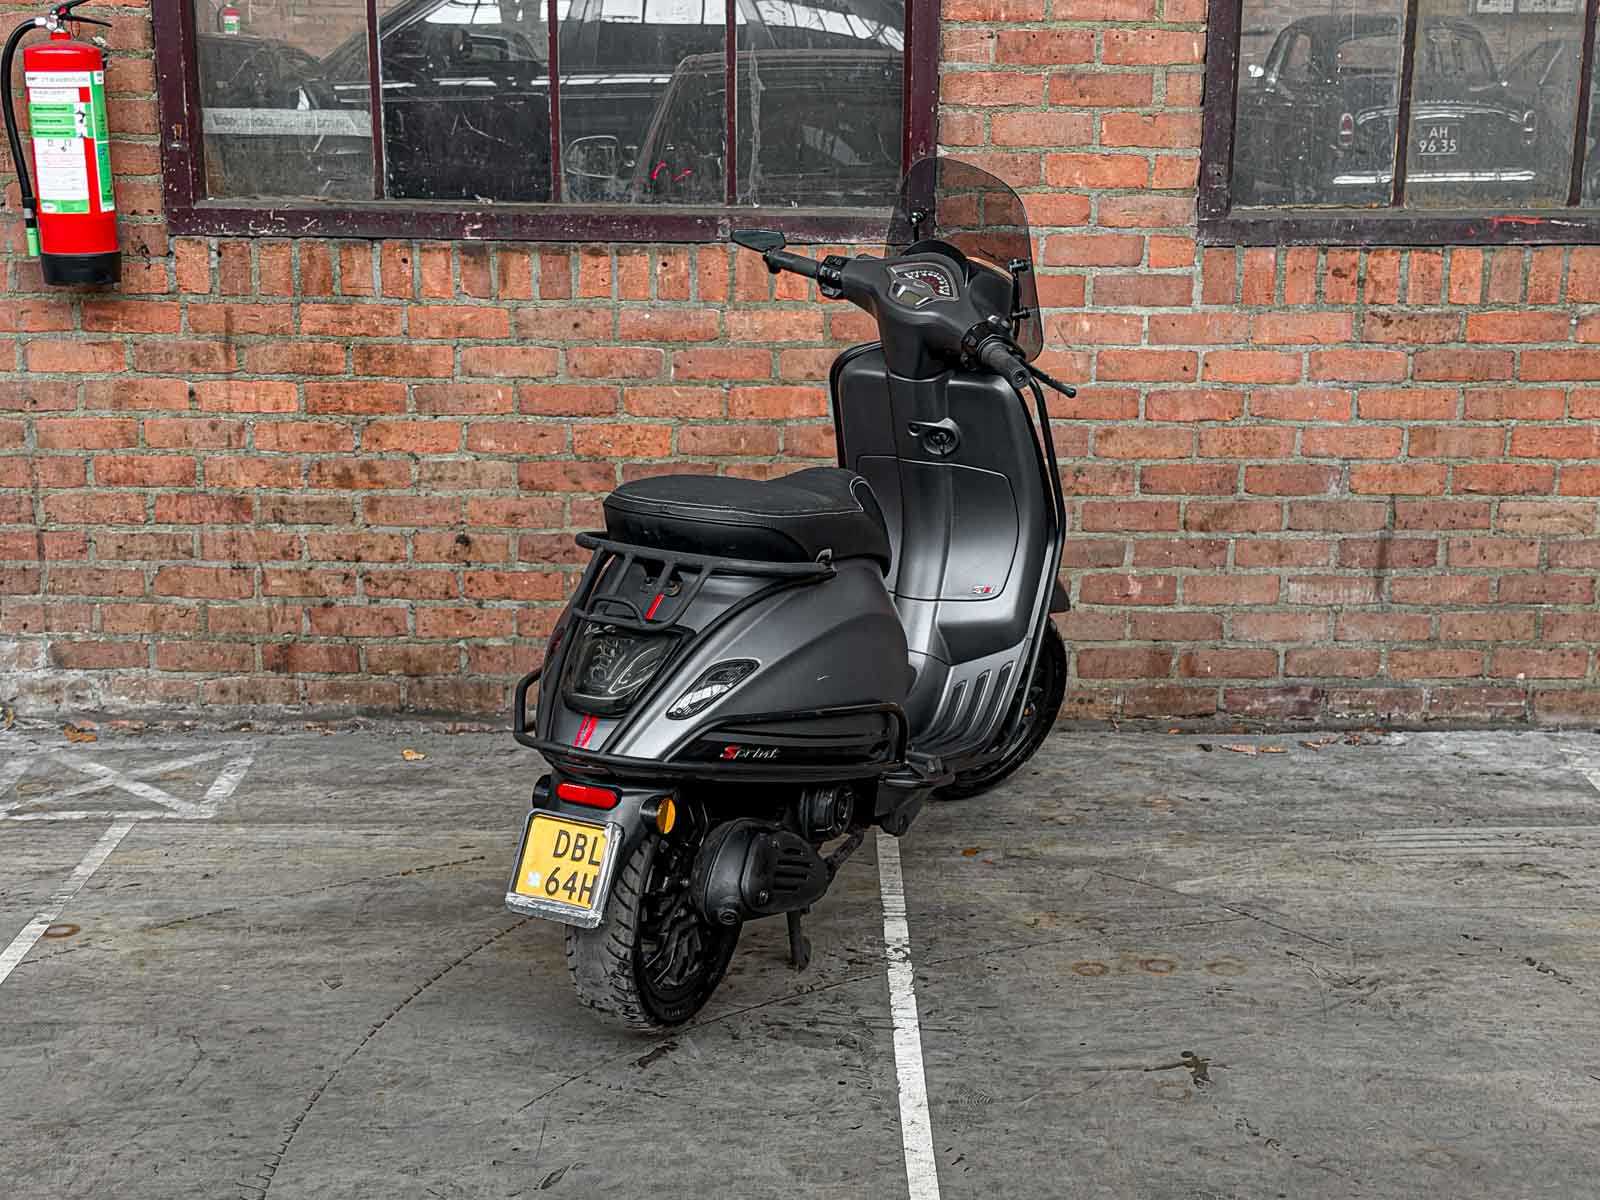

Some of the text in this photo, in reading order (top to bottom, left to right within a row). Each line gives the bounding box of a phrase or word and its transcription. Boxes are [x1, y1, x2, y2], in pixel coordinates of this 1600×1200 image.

[1428, 126, 1449, 139] AH
[720, 744, 779, 760] Sprint
[552, 828, 601, 866] DBL
[544, 866, 598, 905] 64H
